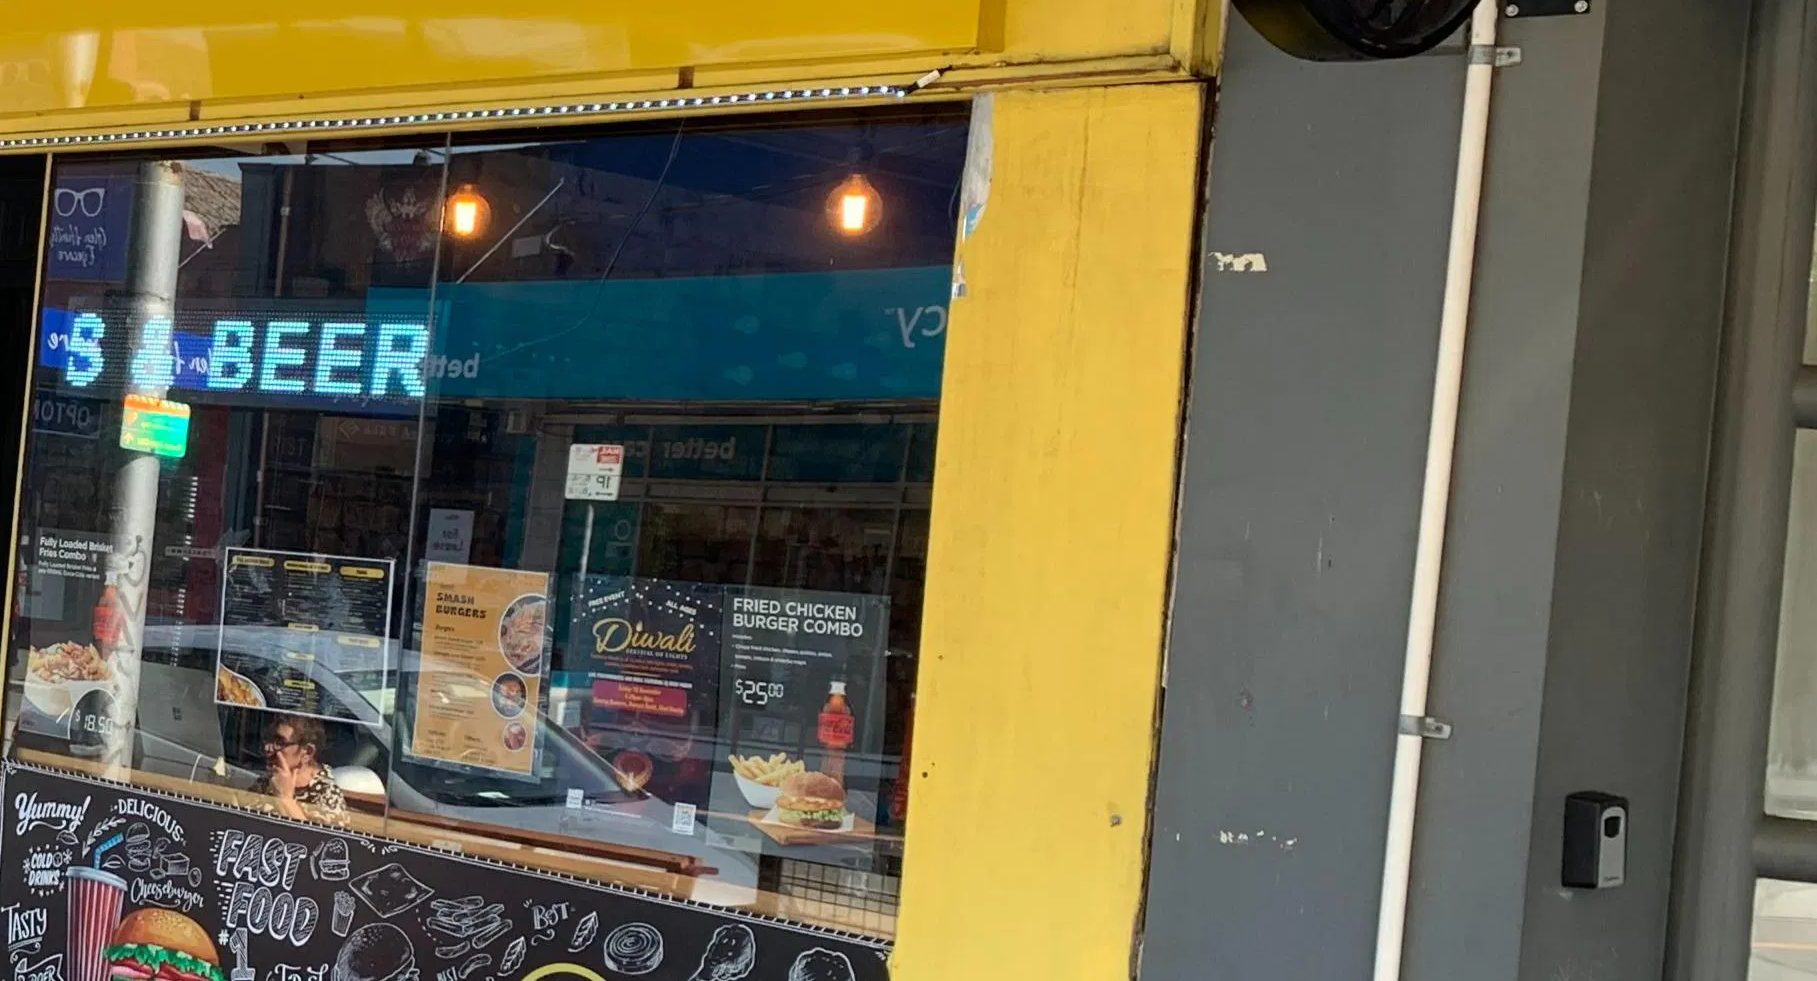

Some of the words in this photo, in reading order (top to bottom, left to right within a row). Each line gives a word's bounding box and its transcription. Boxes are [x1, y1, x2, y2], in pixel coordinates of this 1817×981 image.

[206, 320, 430, 397] BEER
[39, 536, 58, 549] Fully
[59, 538, 88, 551] Loaded
[39, 547, 58, 559] Fries
[58, 548, 87, 561] Combo
[435, 604, 487, 619] BURGERS
[436, 592, 475, 605] SMASH
[733, 597, 781, 615] FRIED
[785, 601, 857, 621] CHICKEN
[592, 617, 697, 653] Diwali
[732, 613, 799, 633] BURGER
[803, 619, 863, 637] COMBO
[14, 792, 92, 836] Yummy!
[117, 798, 185, 843] DELICIOUS
[30, 852, 54, 869] COLD
[215, 829, 307, 890] FAST
[27, 869, 61, 887] DRINKS
[0, 902, 47, 945] TASTY
[225, 882, 320, 947] FOOD
[532, 902, 570, 930] BEST
